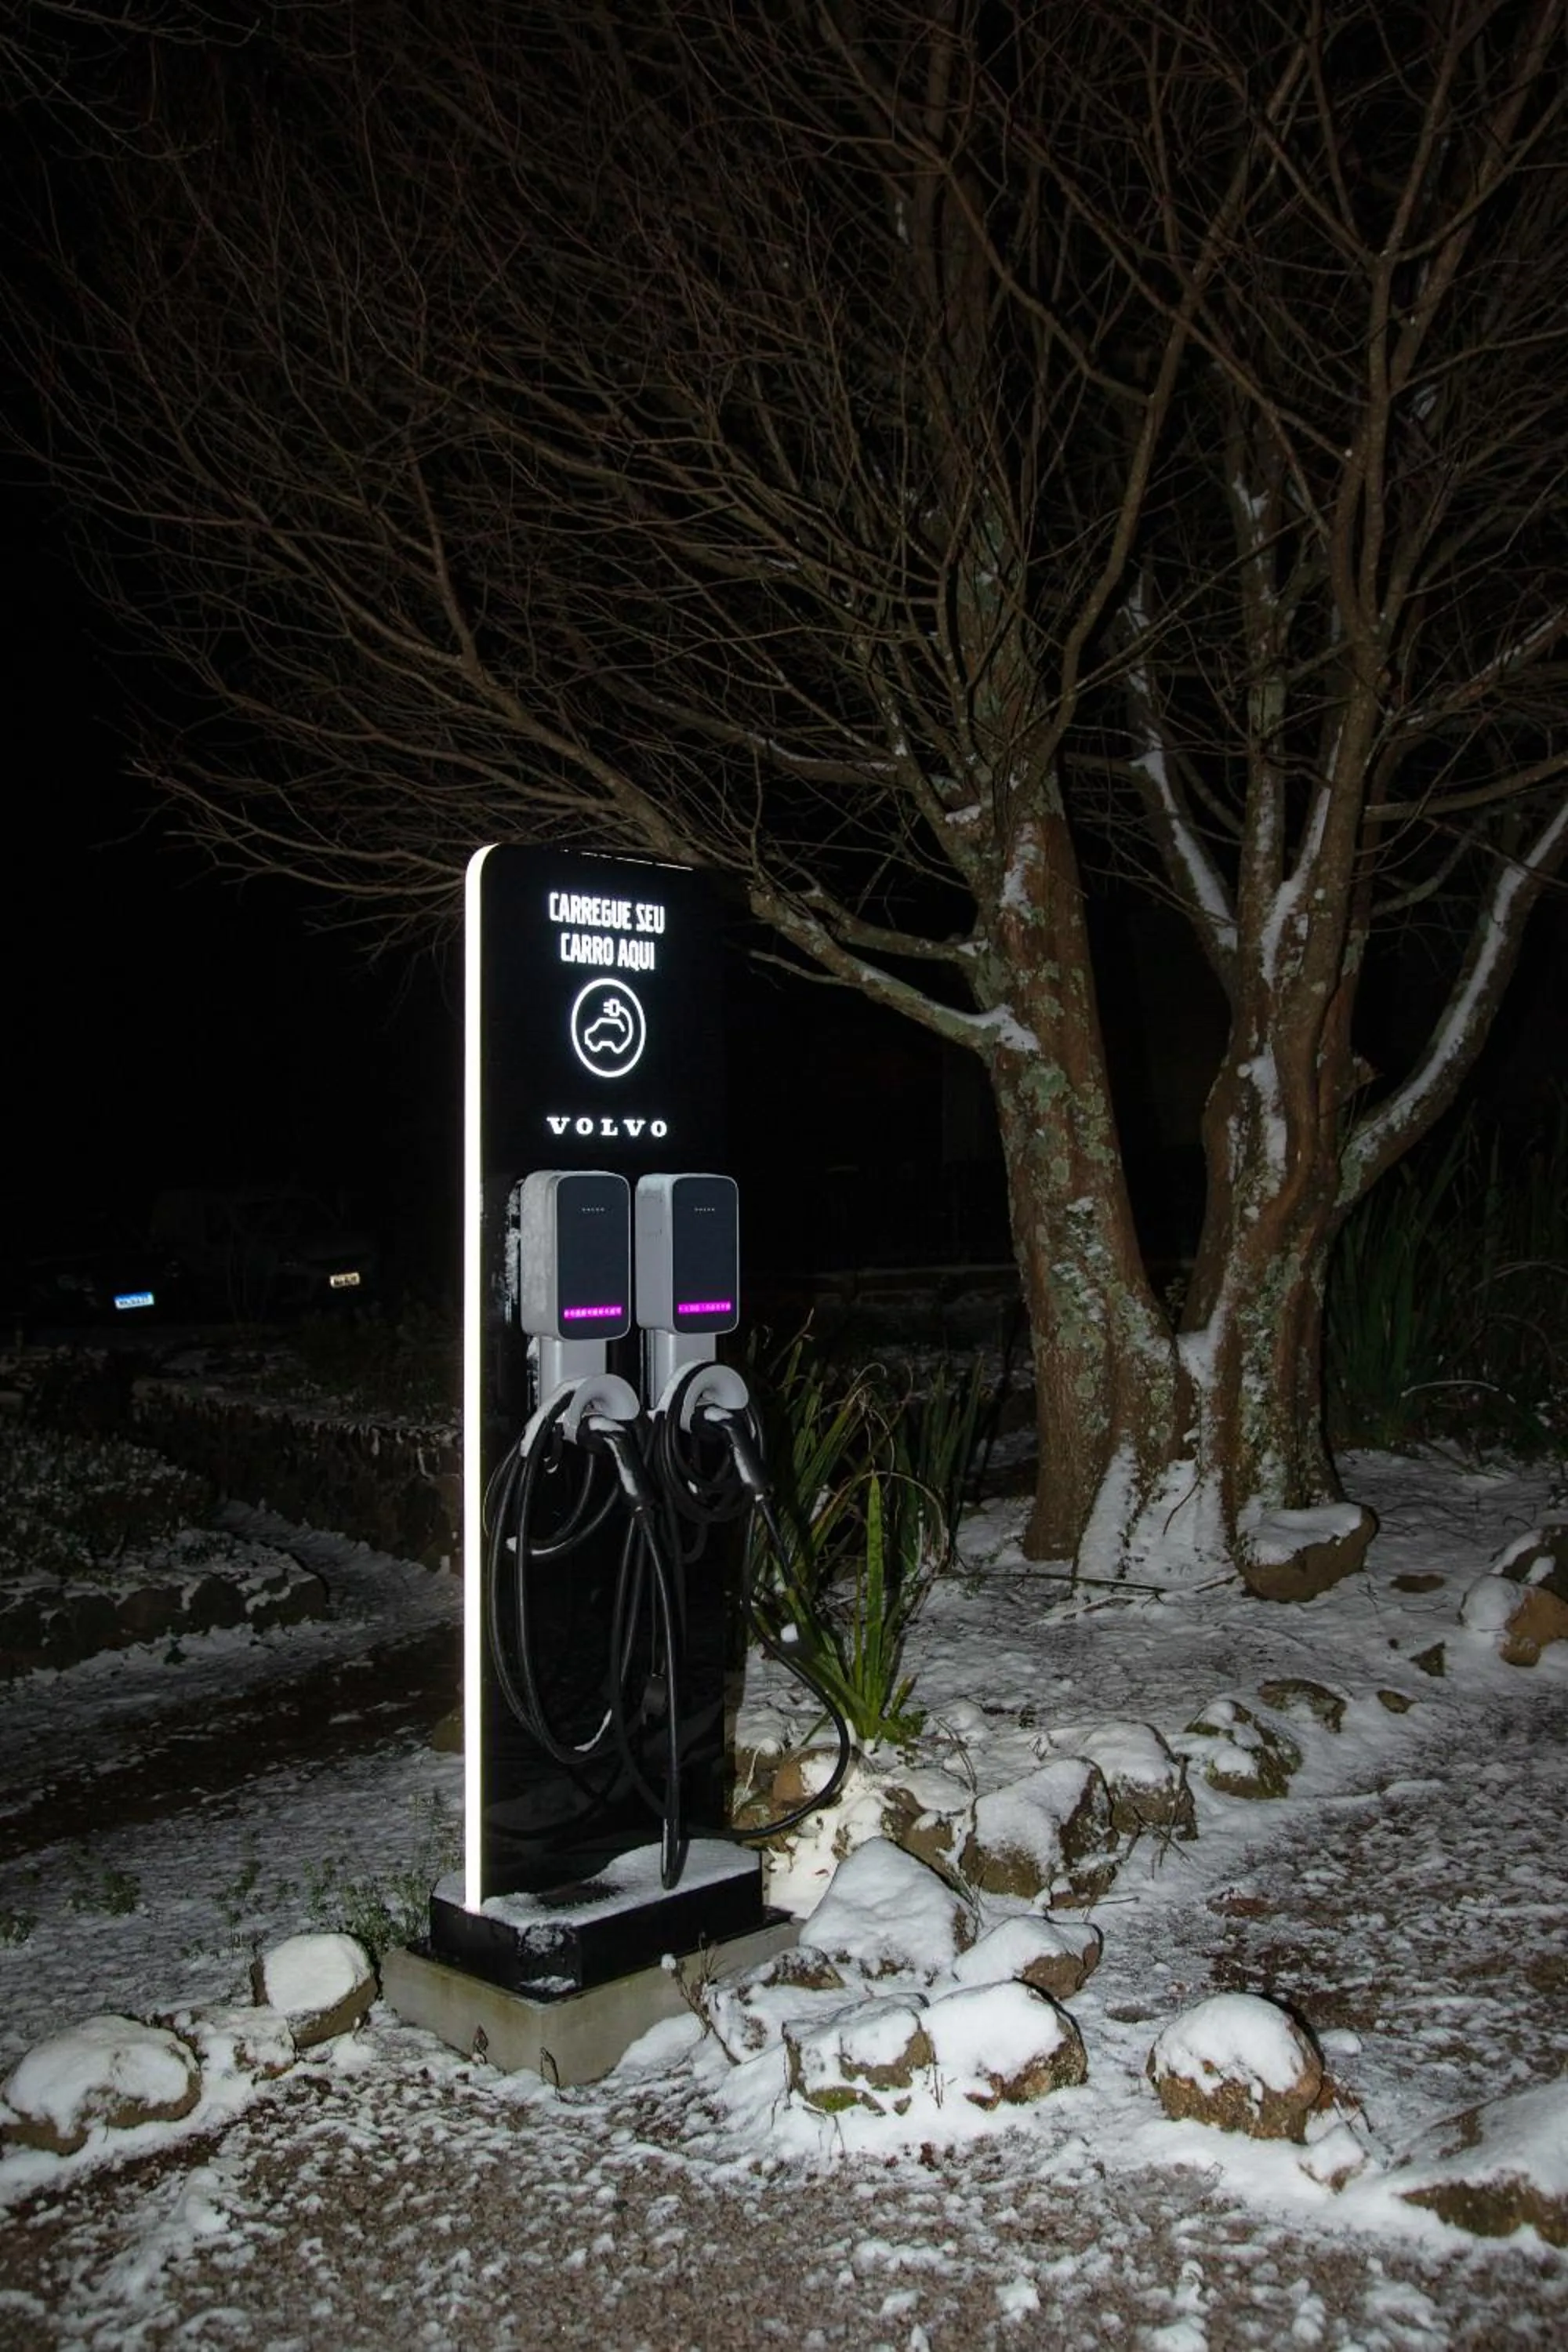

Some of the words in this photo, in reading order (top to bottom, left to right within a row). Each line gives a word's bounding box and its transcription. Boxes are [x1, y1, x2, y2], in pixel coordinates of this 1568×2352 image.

[549, 891, 633, 930] CARREGUE
[636, 902, 666, 934] SEU
[561, 932, 615, 966] CARRO
[617, 938, 655, 971] AQUI
[546, 1116, 668, 1138] VOLVO
